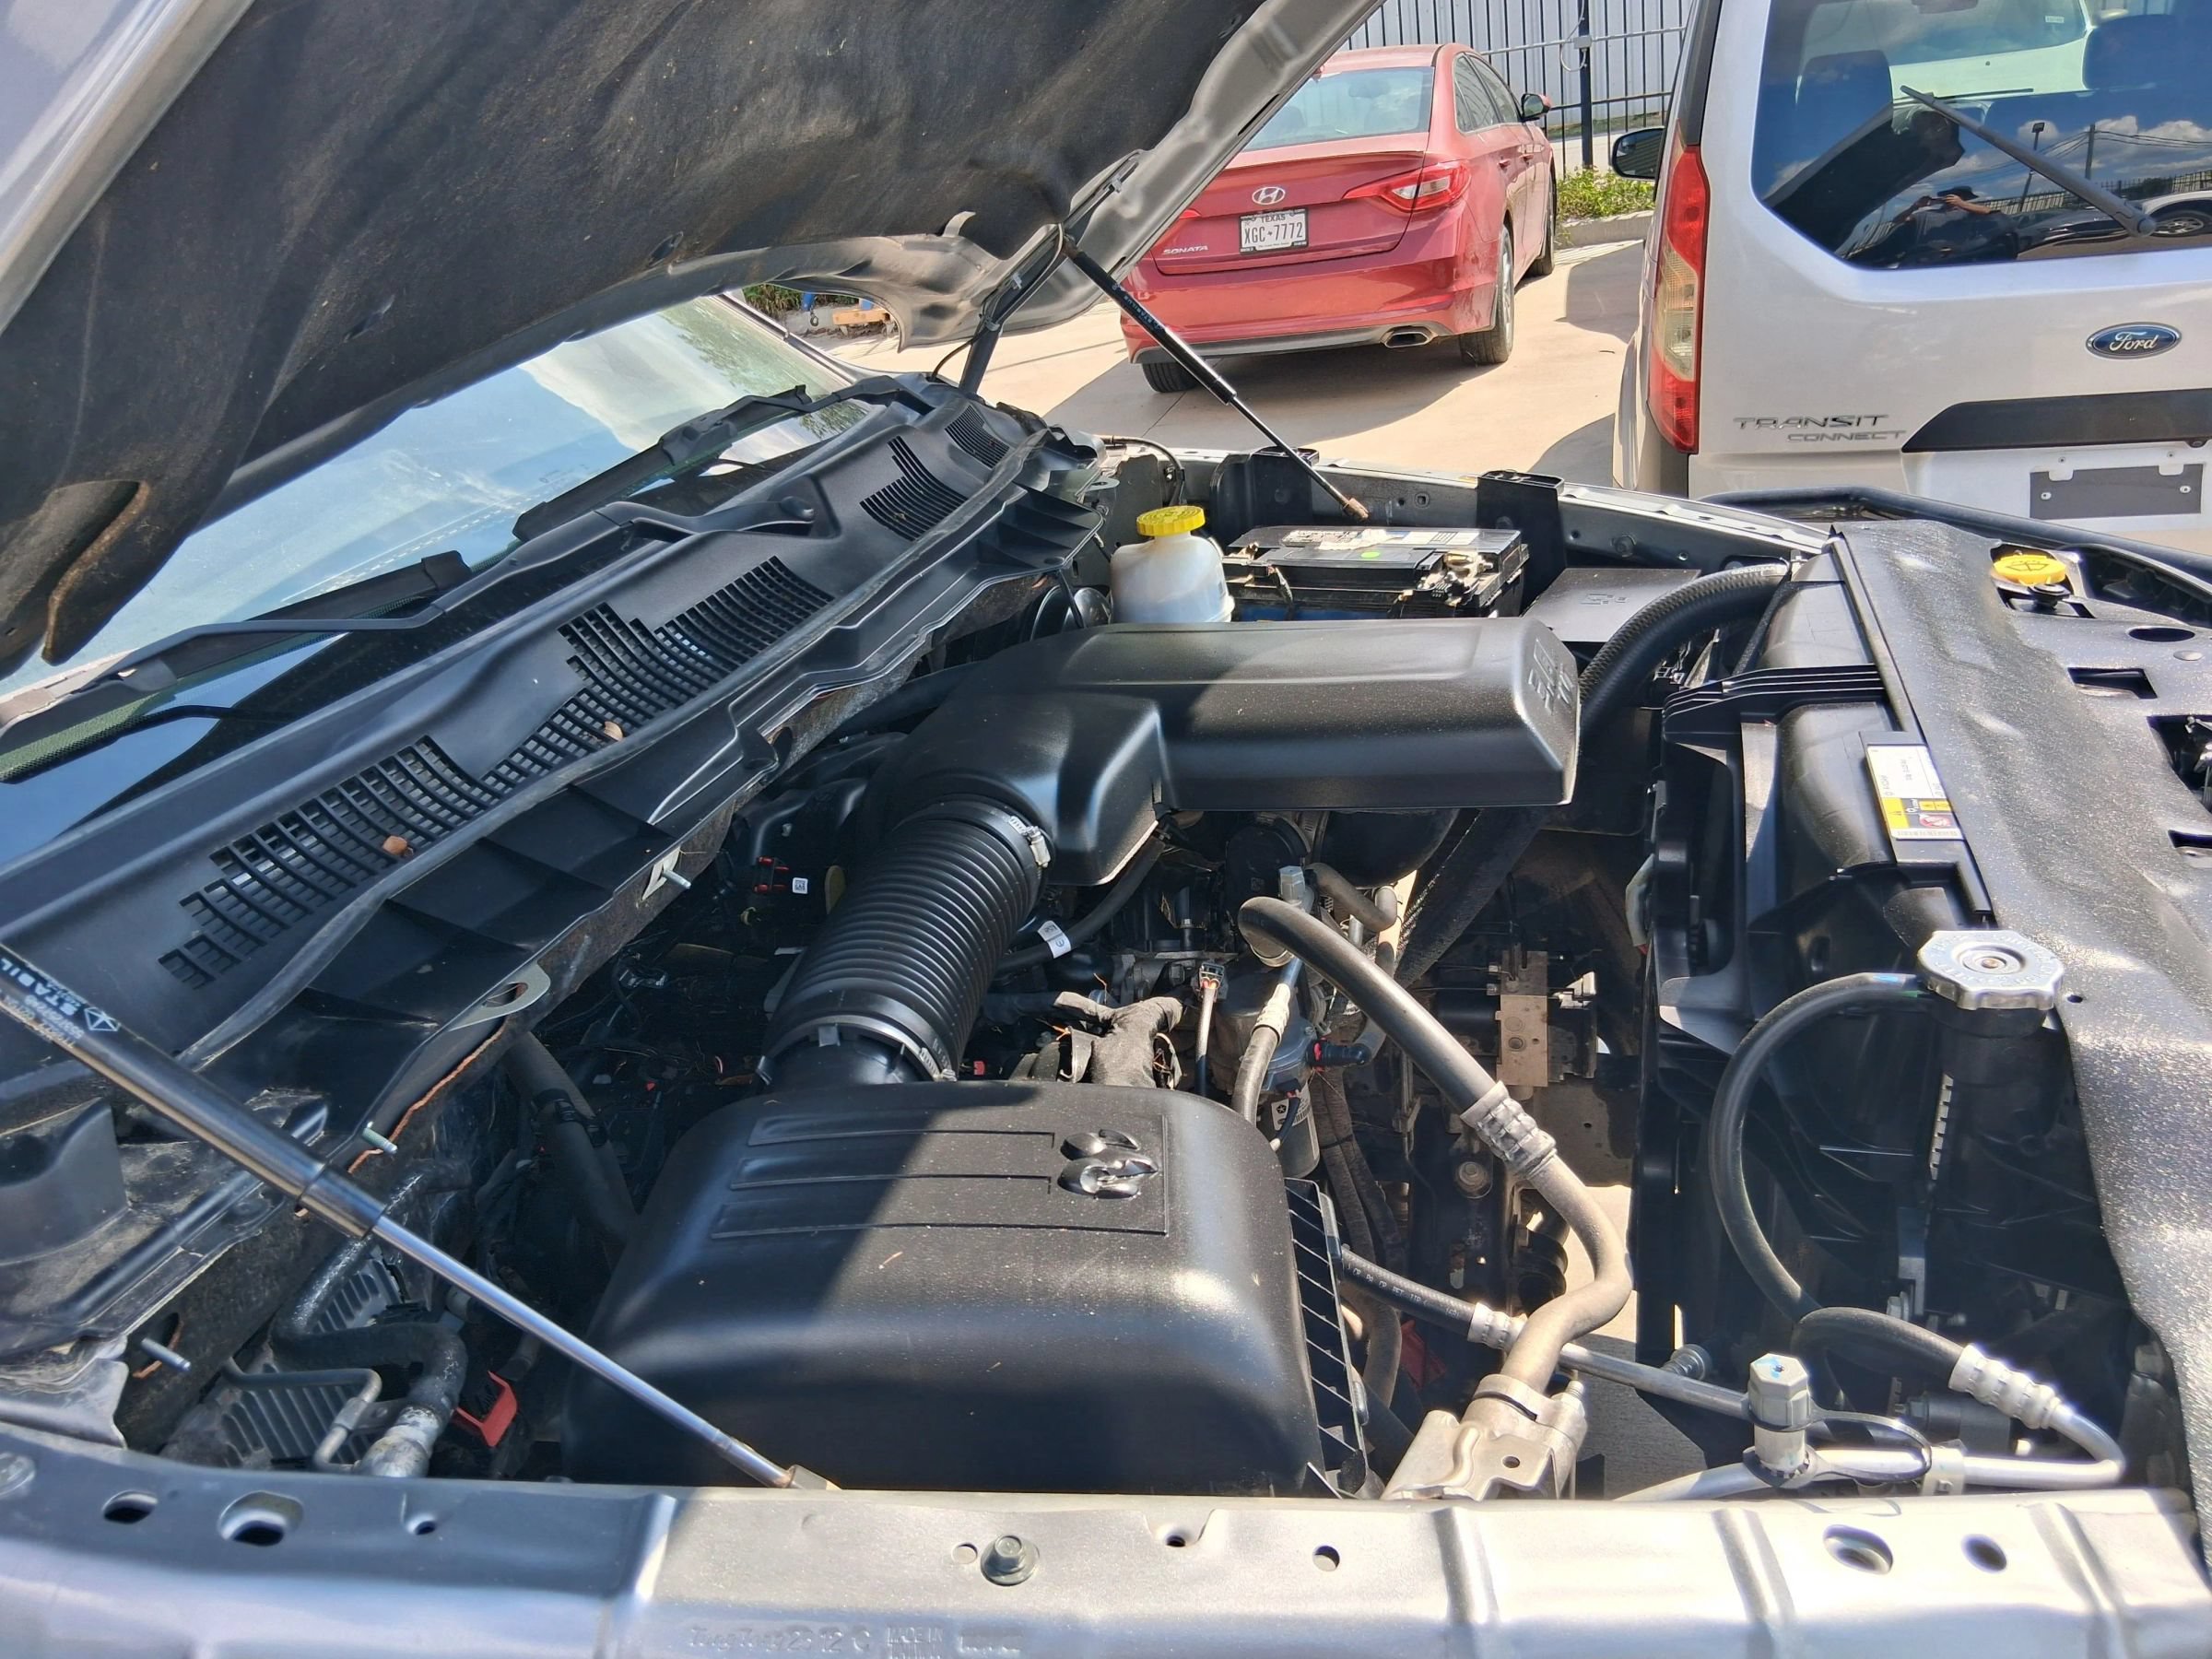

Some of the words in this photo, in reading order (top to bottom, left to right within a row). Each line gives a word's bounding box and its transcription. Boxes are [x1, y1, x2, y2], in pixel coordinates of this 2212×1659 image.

[1261, 214, 1286, 223] TEXAS
[1162, 245, 1208, 255] SONATA
[2109, 331, 2159, 351] Ford
[1733, 415, 1888, 429] TRANSIT
[1786, 429, 1907, 442] CONNECT
[1, 957, 77, 1016] STABIL
